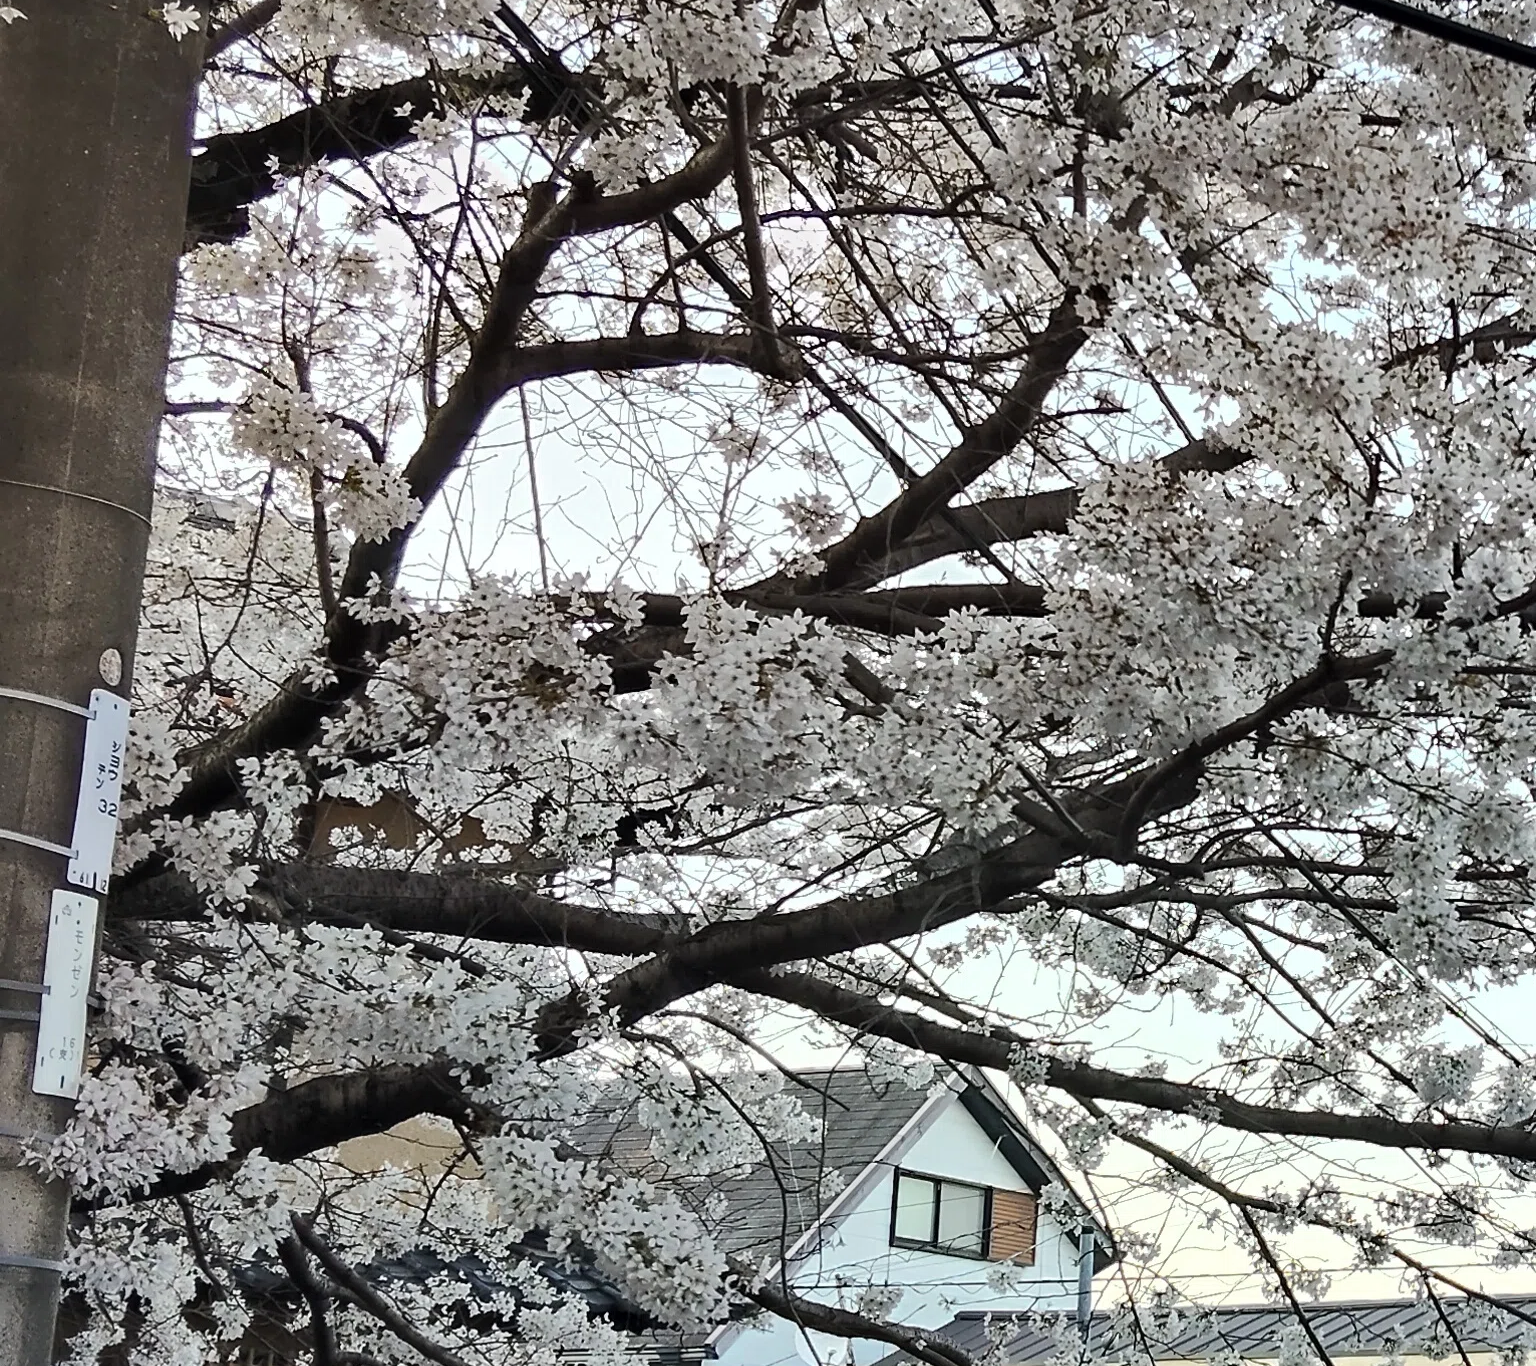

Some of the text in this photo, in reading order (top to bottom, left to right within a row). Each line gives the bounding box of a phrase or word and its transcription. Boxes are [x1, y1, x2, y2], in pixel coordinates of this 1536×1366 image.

[98, 798, 118, 818] 32
[70, 929, 85, 998] モンゼン
[63, 1036, 76, 1048] 16
